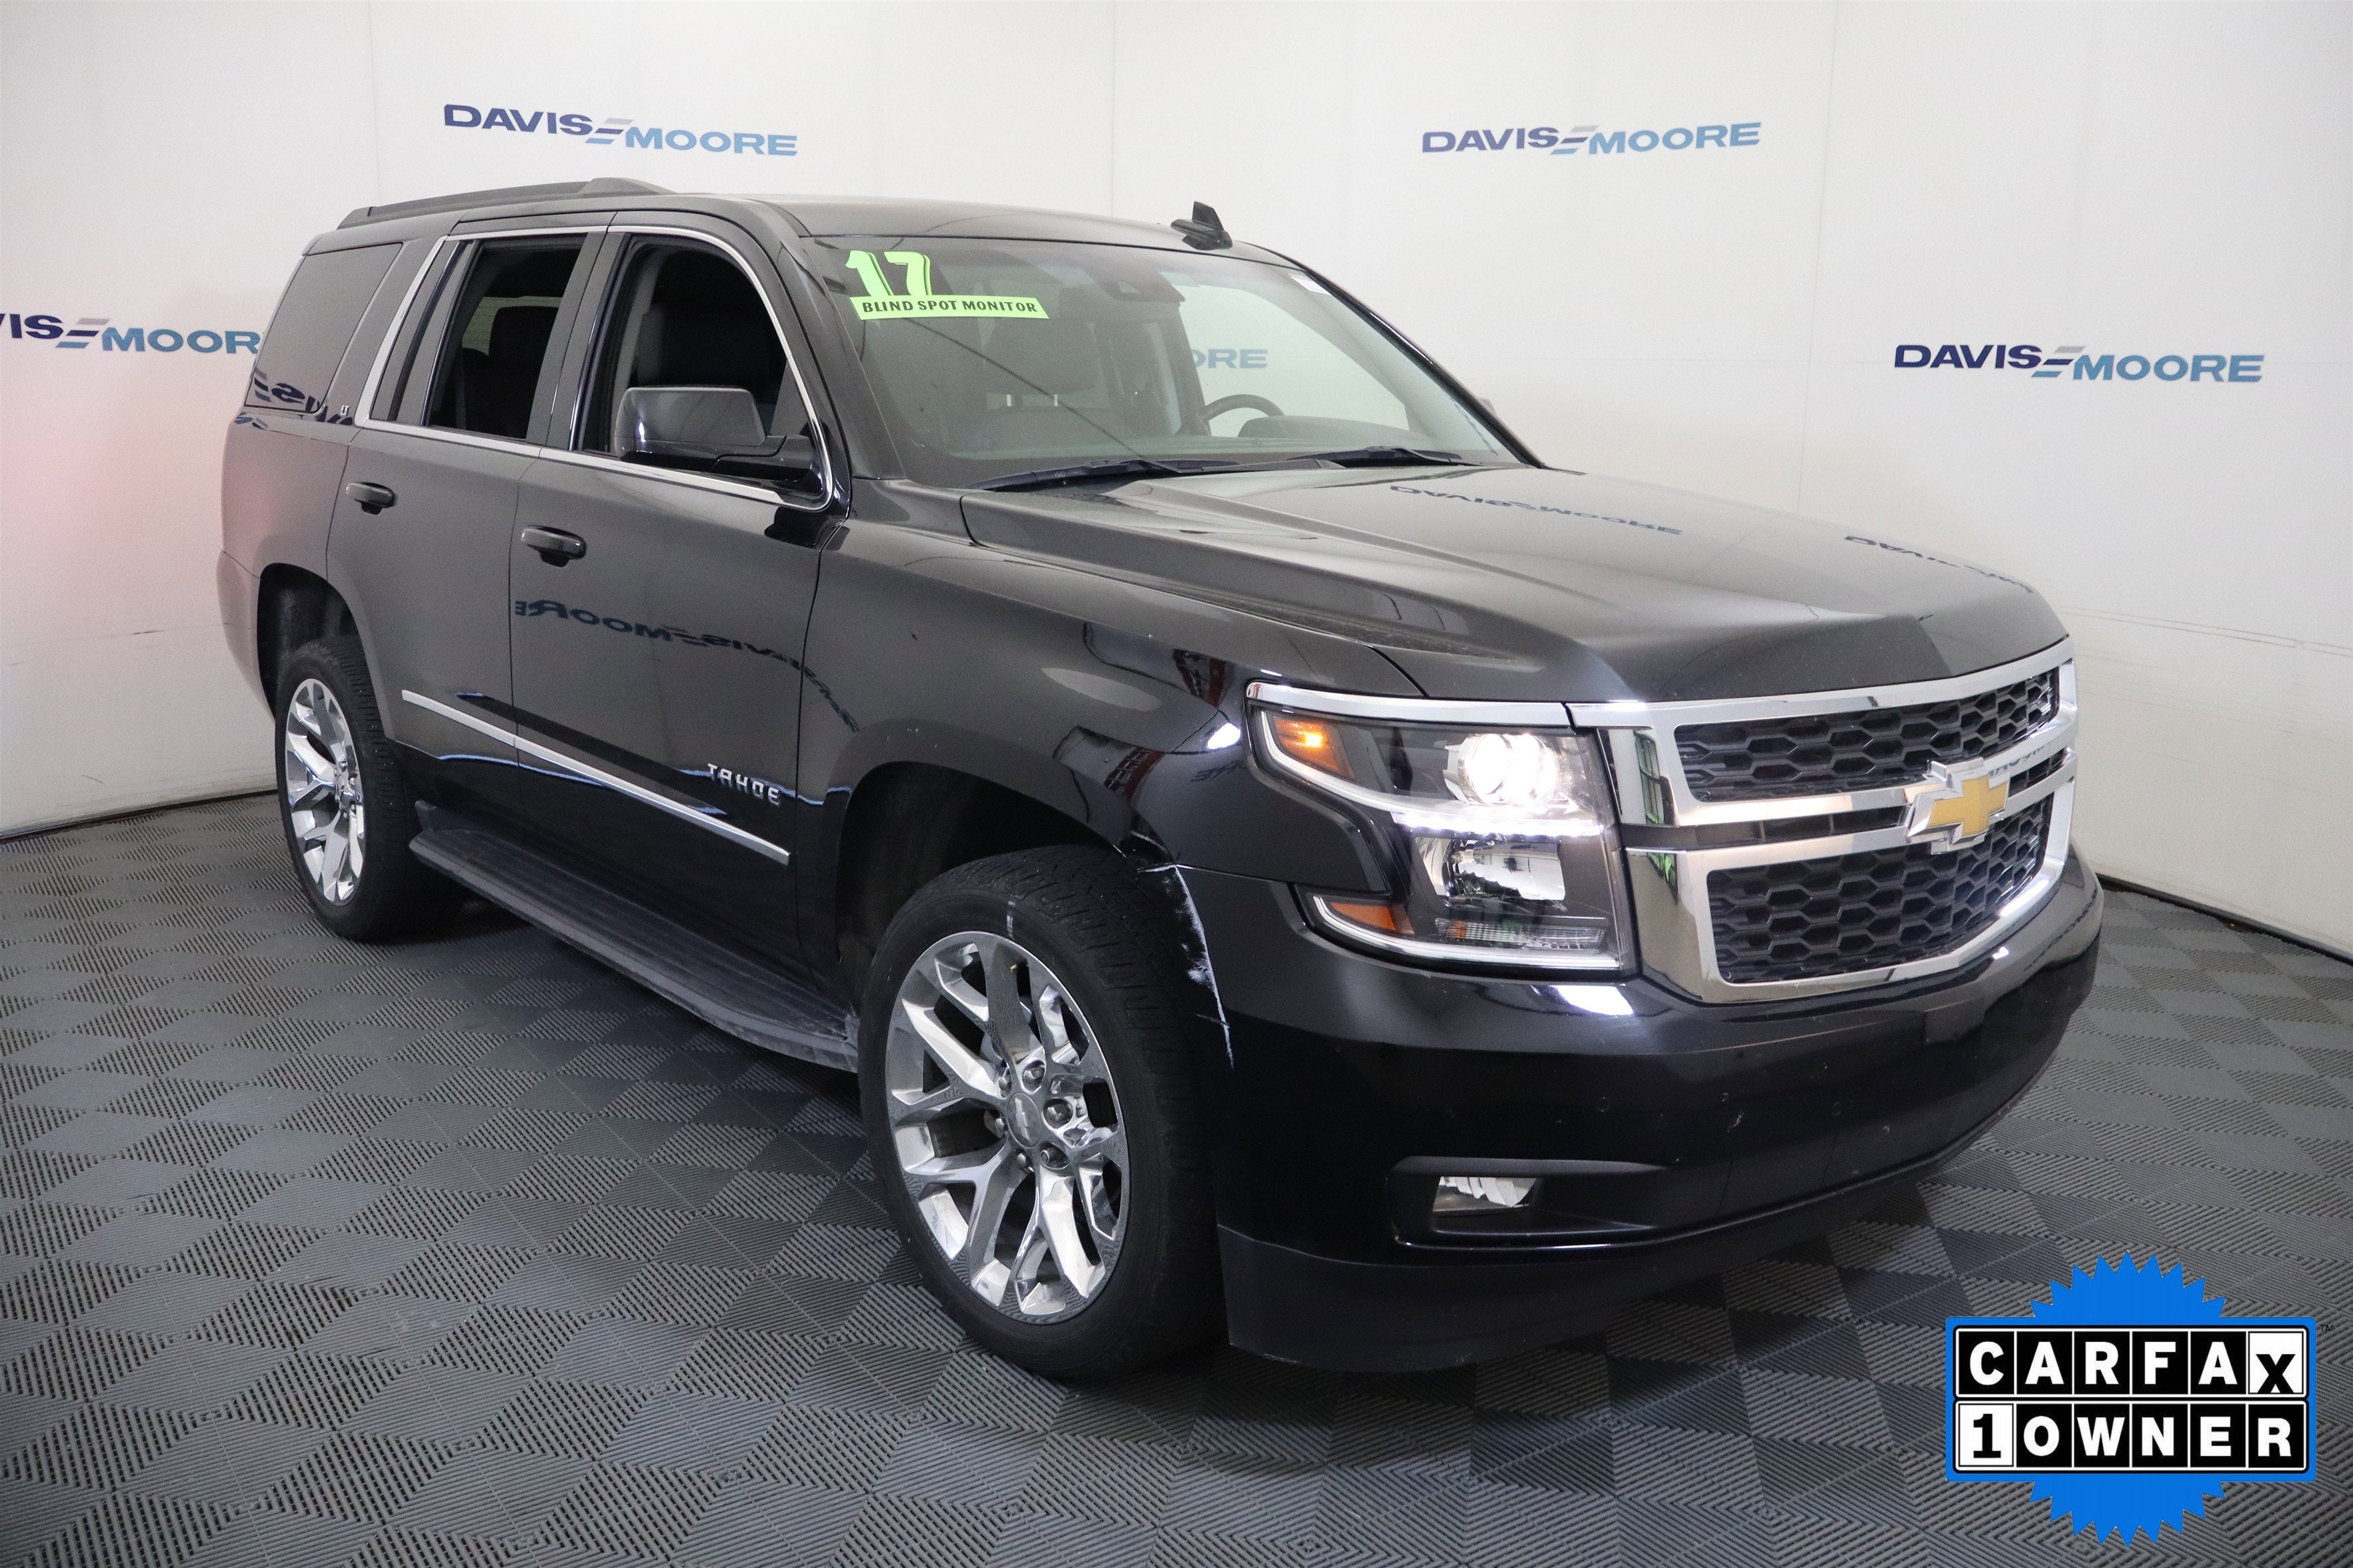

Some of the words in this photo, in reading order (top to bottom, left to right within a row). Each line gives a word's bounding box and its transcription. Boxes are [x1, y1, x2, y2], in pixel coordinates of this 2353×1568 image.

[444, 104, 593, 136] DAVIS
[625, 126, 797, 156] MOORE
[1422, 127, 1559, 153] DAVIS
[1588, 122, 1761, 155] MOORE
[845, 250, 932, 296] 17
[862, 300, 913, 312] BLIND
[917, 300, 957, 311] SPOT
[962, 300, 1038, 312] MONITOR
[0, 313, 64, 339] IS
[102, 327, 263, 354] MOOR
[1893, 344, 2043, 369] DAVIS
[2072, 354, 2265, 382] MOORE
[707, 763, 780, 805] TAHOE
